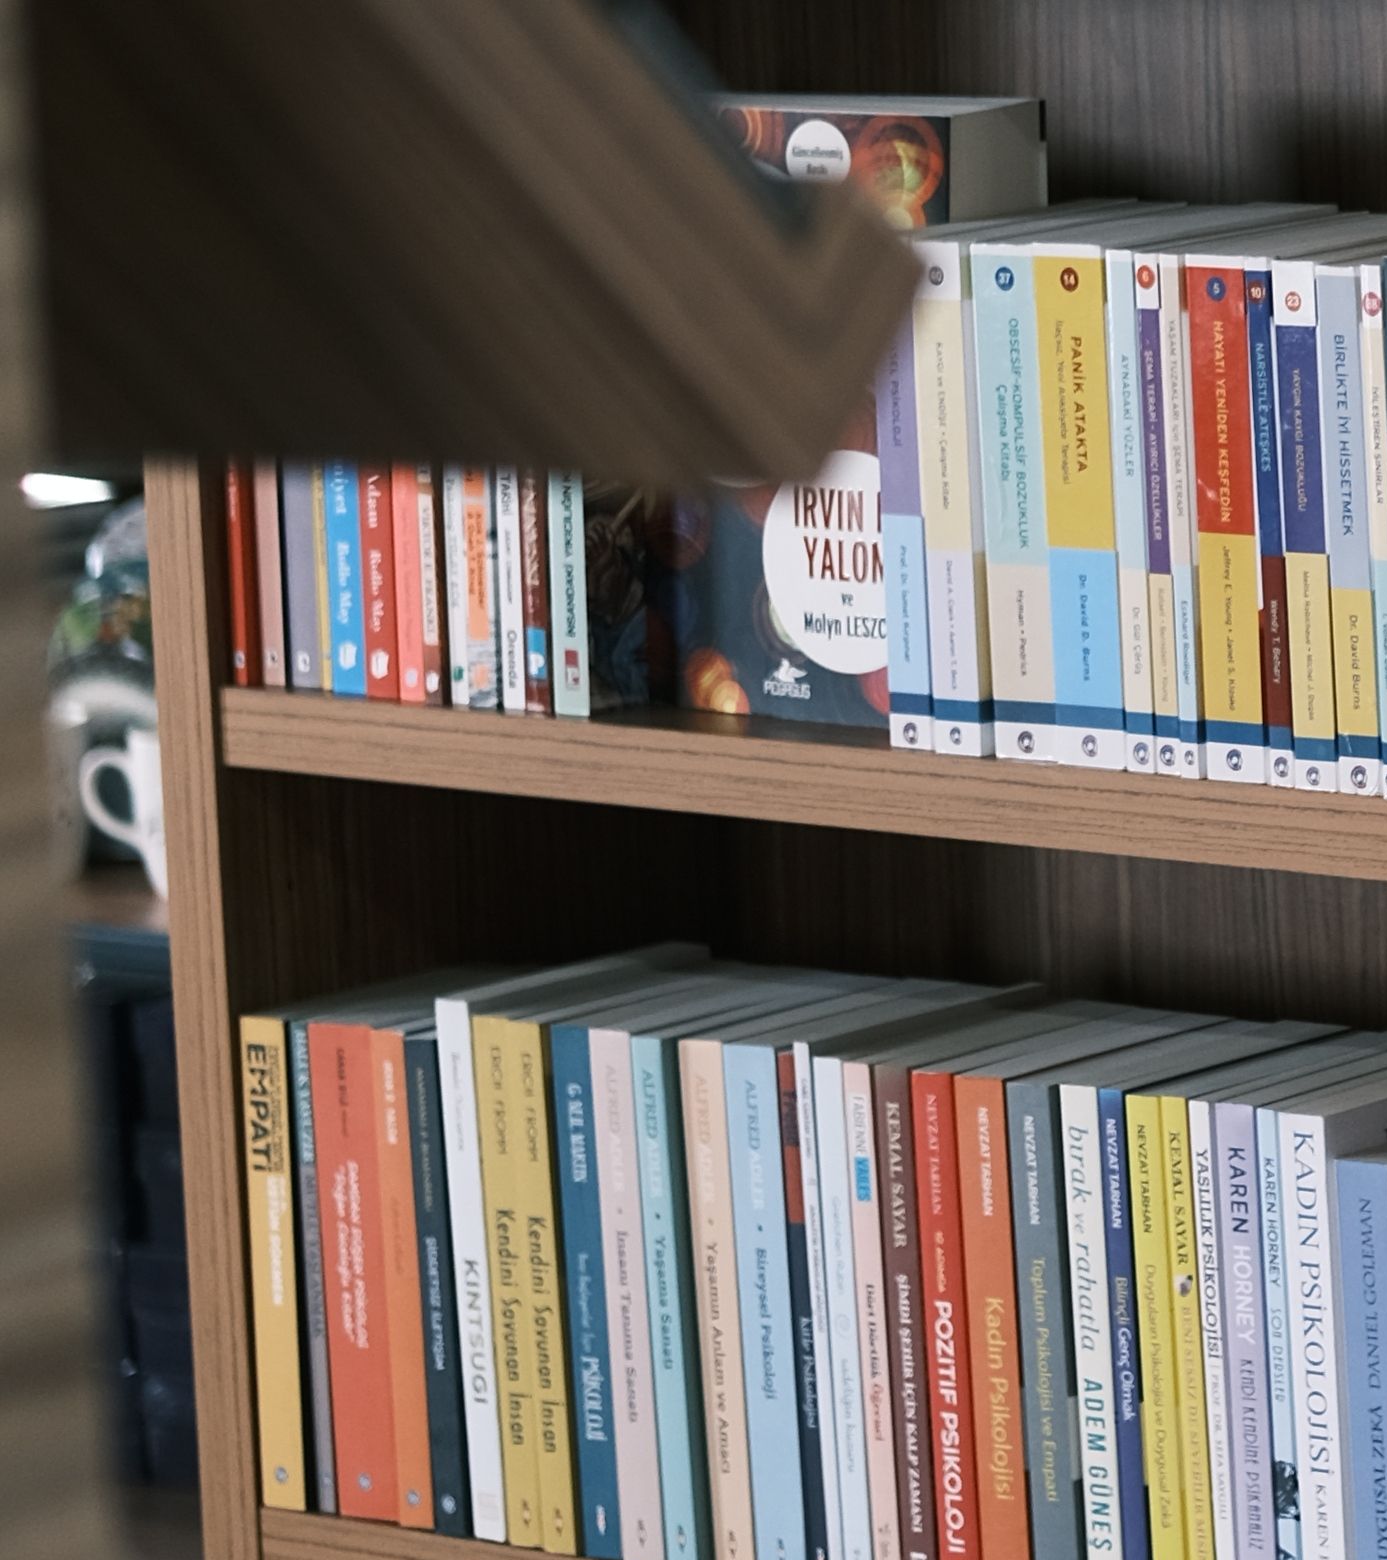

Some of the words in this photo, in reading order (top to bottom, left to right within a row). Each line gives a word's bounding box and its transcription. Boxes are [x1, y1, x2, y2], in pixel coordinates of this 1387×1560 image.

[1213, 321, 1228, 374] HAYATI
[1334, 334, 1352, 411] BİRLİKTE
[1213, 378, 1231, 446] YENİDEN
[1336, 416, 1353, 435] İYİ
[793, 487, 865, 532] IRVIN
[1214, 450, 1234, 523] KEŞFEDİN
[1337, 439, 1355, 536] HİSSETMEK
[803, 611, 842, 638] Molyn
[840, 590, 854, 608] ve
[248, 1043, 273, 1173] EMPATİ
[1225, 1146, 1252, 1234] KAREN
[1292, 1130, 1323, 1247] KADIN
[527, 1215, 552, 1293] Kendini
[463, 1259, 488, 1404] KINTSUGI
[1229, 1244, 1256, 1345] HORNEY
[531, 1299, 558, 1389] Savunan
[1296, 1260, 1334, 1476] PSİKOLOJİSİ
[537, 1400, 563, 1453] İnsan
[1083, 1378, 1109, 1452] ADEM
[1086, 1464, 1113, 1552] GÜNEŞ
